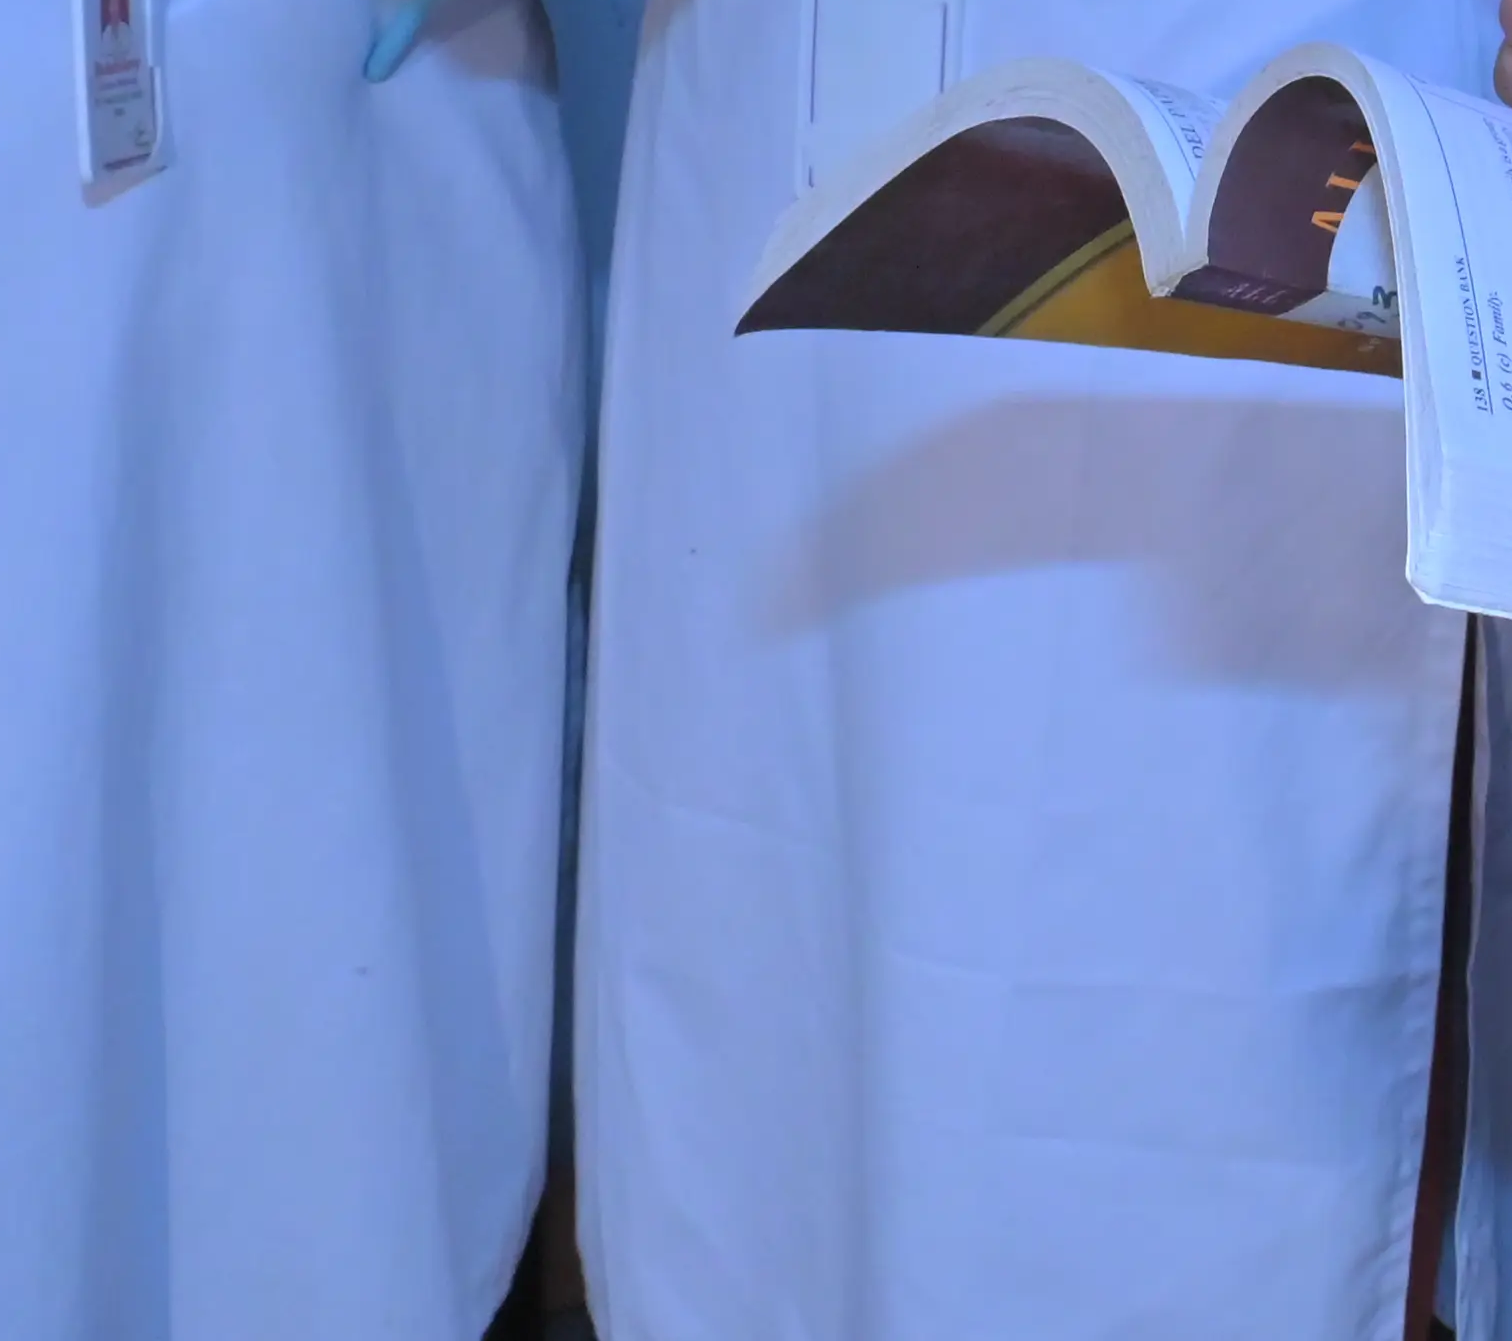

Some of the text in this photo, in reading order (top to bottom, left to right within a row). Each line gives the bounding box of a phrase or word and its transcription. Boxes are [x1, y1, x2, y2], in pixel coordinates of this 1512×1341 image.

[1459, 295, 1483, 368] QUESTION
[1484, 289, 1510, 348] Family:
[1472, 385, 1490, 414] 138
